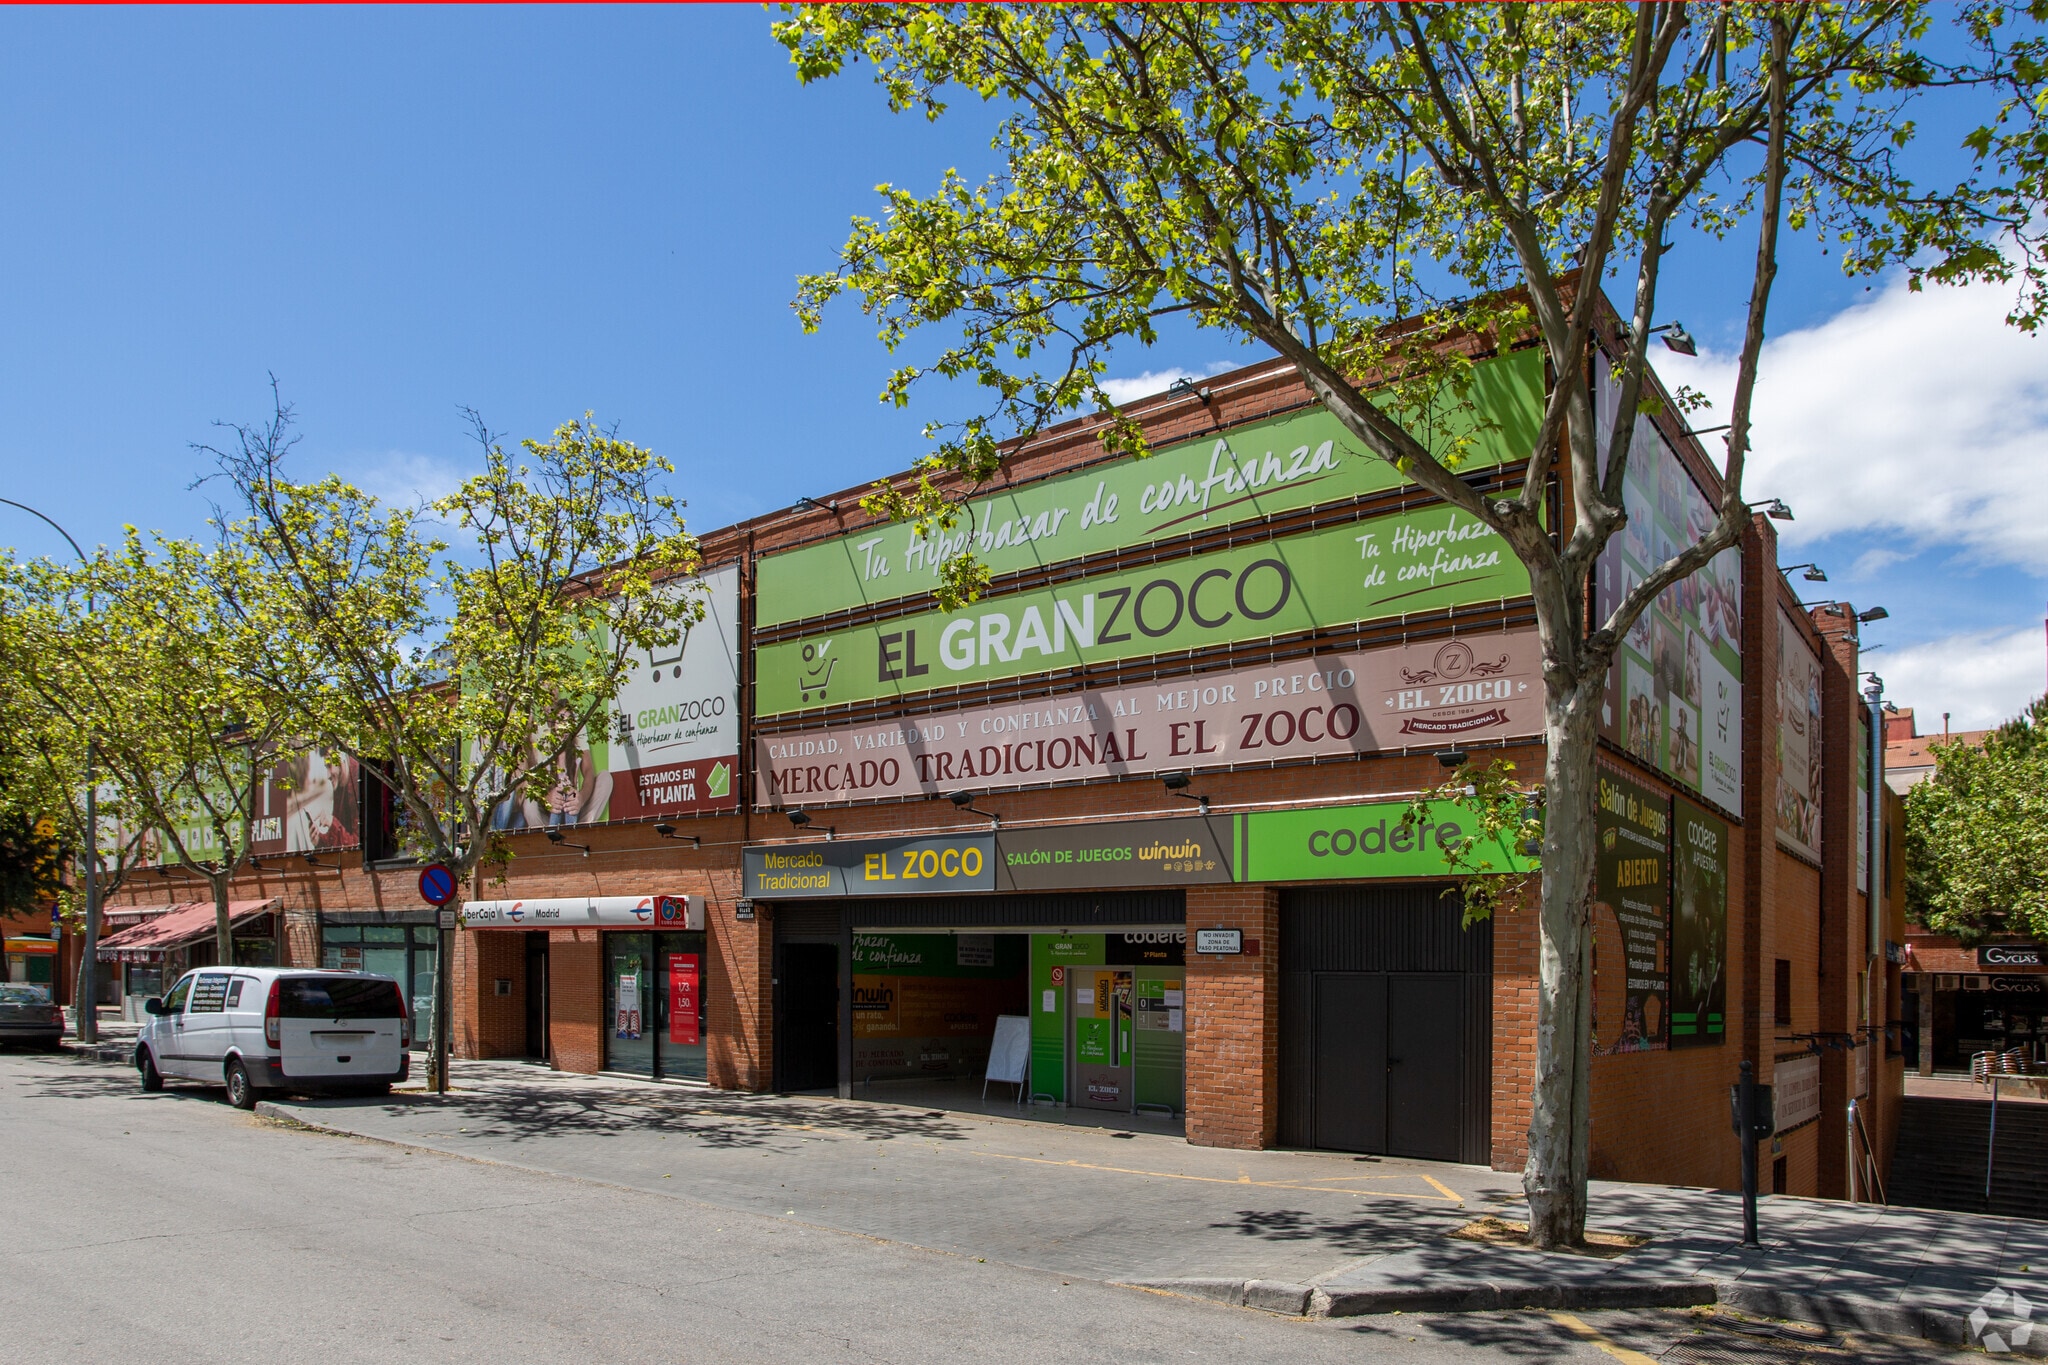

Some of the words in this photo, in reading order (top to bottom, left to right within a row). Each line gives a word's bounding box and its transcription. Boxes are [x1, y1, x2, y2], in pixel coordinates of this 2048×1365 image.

[856, 537, 890, 582] Tu
[904, 500, 1070, 579] Hiperbazar
[1079, 480, 1120, 531] de
[1139, 437, 1341, 522] confianza
[1355, 533, 1381, 559] Tu
[1391, 513, 1498, 556] Hiperbaza
[1363, 564, 1386, 589] de
[1397, 547, 1502, 585] confianza
[877, 628, 929, 683] EL
[938, 557, 1292, 671] GRANZOCO
[1397, 689, 1431, 710] EL
[1439, 679, 1512, 706] ZOCO
[620, 714, 635, 733] EL
[637, 696, 725, 729] GRANZOCO
[769, 738, 844, 760] CALIDAD,
[853, 724, 945, 750] VARIEDAD
[956, 721, 969, 738] Y
[980, 703, 1099, 735] CONFIANZA
[1113, 697, 1142, 718] AL
[1156, 684, 1237, 713] MEJOR
[1253, 668, 1356, 700] PRECIO
[1413, 722, 1447, 730] MERCADO
[1448, 714, 1496, 730] TRADICIONAL
[1432, 709, 1456, 717] DESDE
[637, 729, 672, 748] Hiperbazar
[674, 728, 682, 739] de
[685, 722, 719, 741] confianza
[769, 757, 900, 796] MERCADO
[915, 728, 1148, 784] TRADICIONAL
[1169, 720, 1217, 757] EL
[1239, 702, 1361, 750] ZOCO
[640, 769, 681, 786] ESTAMOS
[682, 768, 696, 780] EN
[639, 788, 651, 807] 1ª
[653, 783, 696, 805] PLANTA
[1600, 777, 1626, 818] Salón
[1627, 792, 1638, 822] de
[1639, 799, 1666, 838] Juegos
[1308, 819, 1462, 857] codere
[1687, 820, 1717, 854] codere
[765, 850, 823, 869] Mercado
[864, 853, 896, 881] EL
[902, 847, 983, 879] ZOCO
[1007, 849, 1051, 866] SALÓN
[1055, 850, 1072, 864] DE
[1076, 847, 1132, 863] JUEGOS
[1138, 838, 1201, 860] winwin
[1692, 850, 1717, 873] APUESTAS
[758, 871, 830, 890] Tradicional
[1616, 858, 1659, 888] ABIERTO
[535, 907, 560, 919] Madrid
[852, 932, 889, 948] rbazar
[852, 945, 864, 961] de
[869, 943, 922, 970] confianza
[1149, 950, 1168, 958] Planta
[852, 982, 893, 1002] inwin
[1098, 980, 1106, 1012] winwin
[1140, 998, 1146, 1008] 0
[868, 1059, 906, 1067] CONFIANZA
[871, 1049, 904, 1059] MERCADO
[1099, 1085, 1119, 1094] ZOCO
